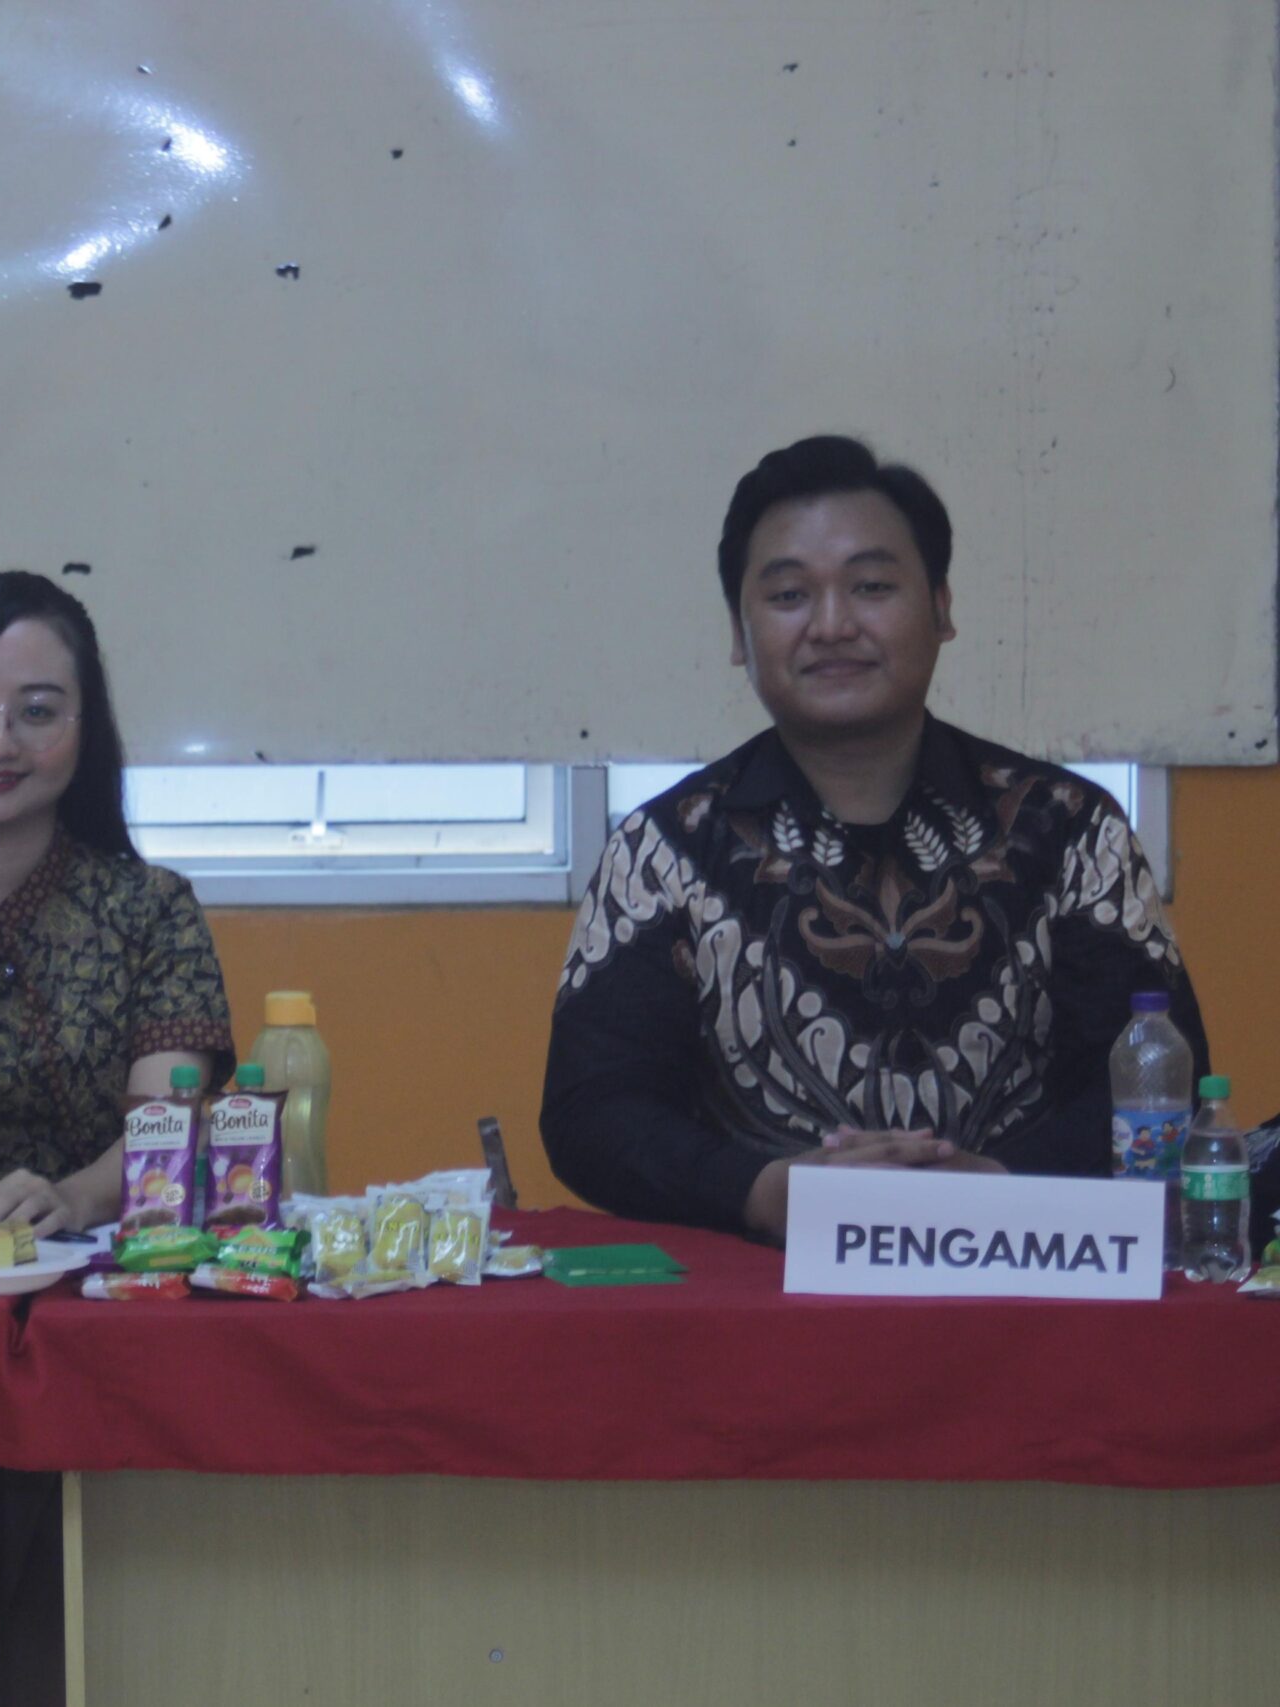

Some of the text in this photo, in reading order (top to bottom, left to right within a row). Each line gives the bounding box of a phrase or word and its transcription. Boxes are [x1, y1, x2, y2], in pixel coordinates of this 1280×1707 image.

[125, 1114, 184, 1137] Bonita
[211, 1109, 269, 1132] Bonita
[835, 1223, 1138, 1274] PENGAMAT
